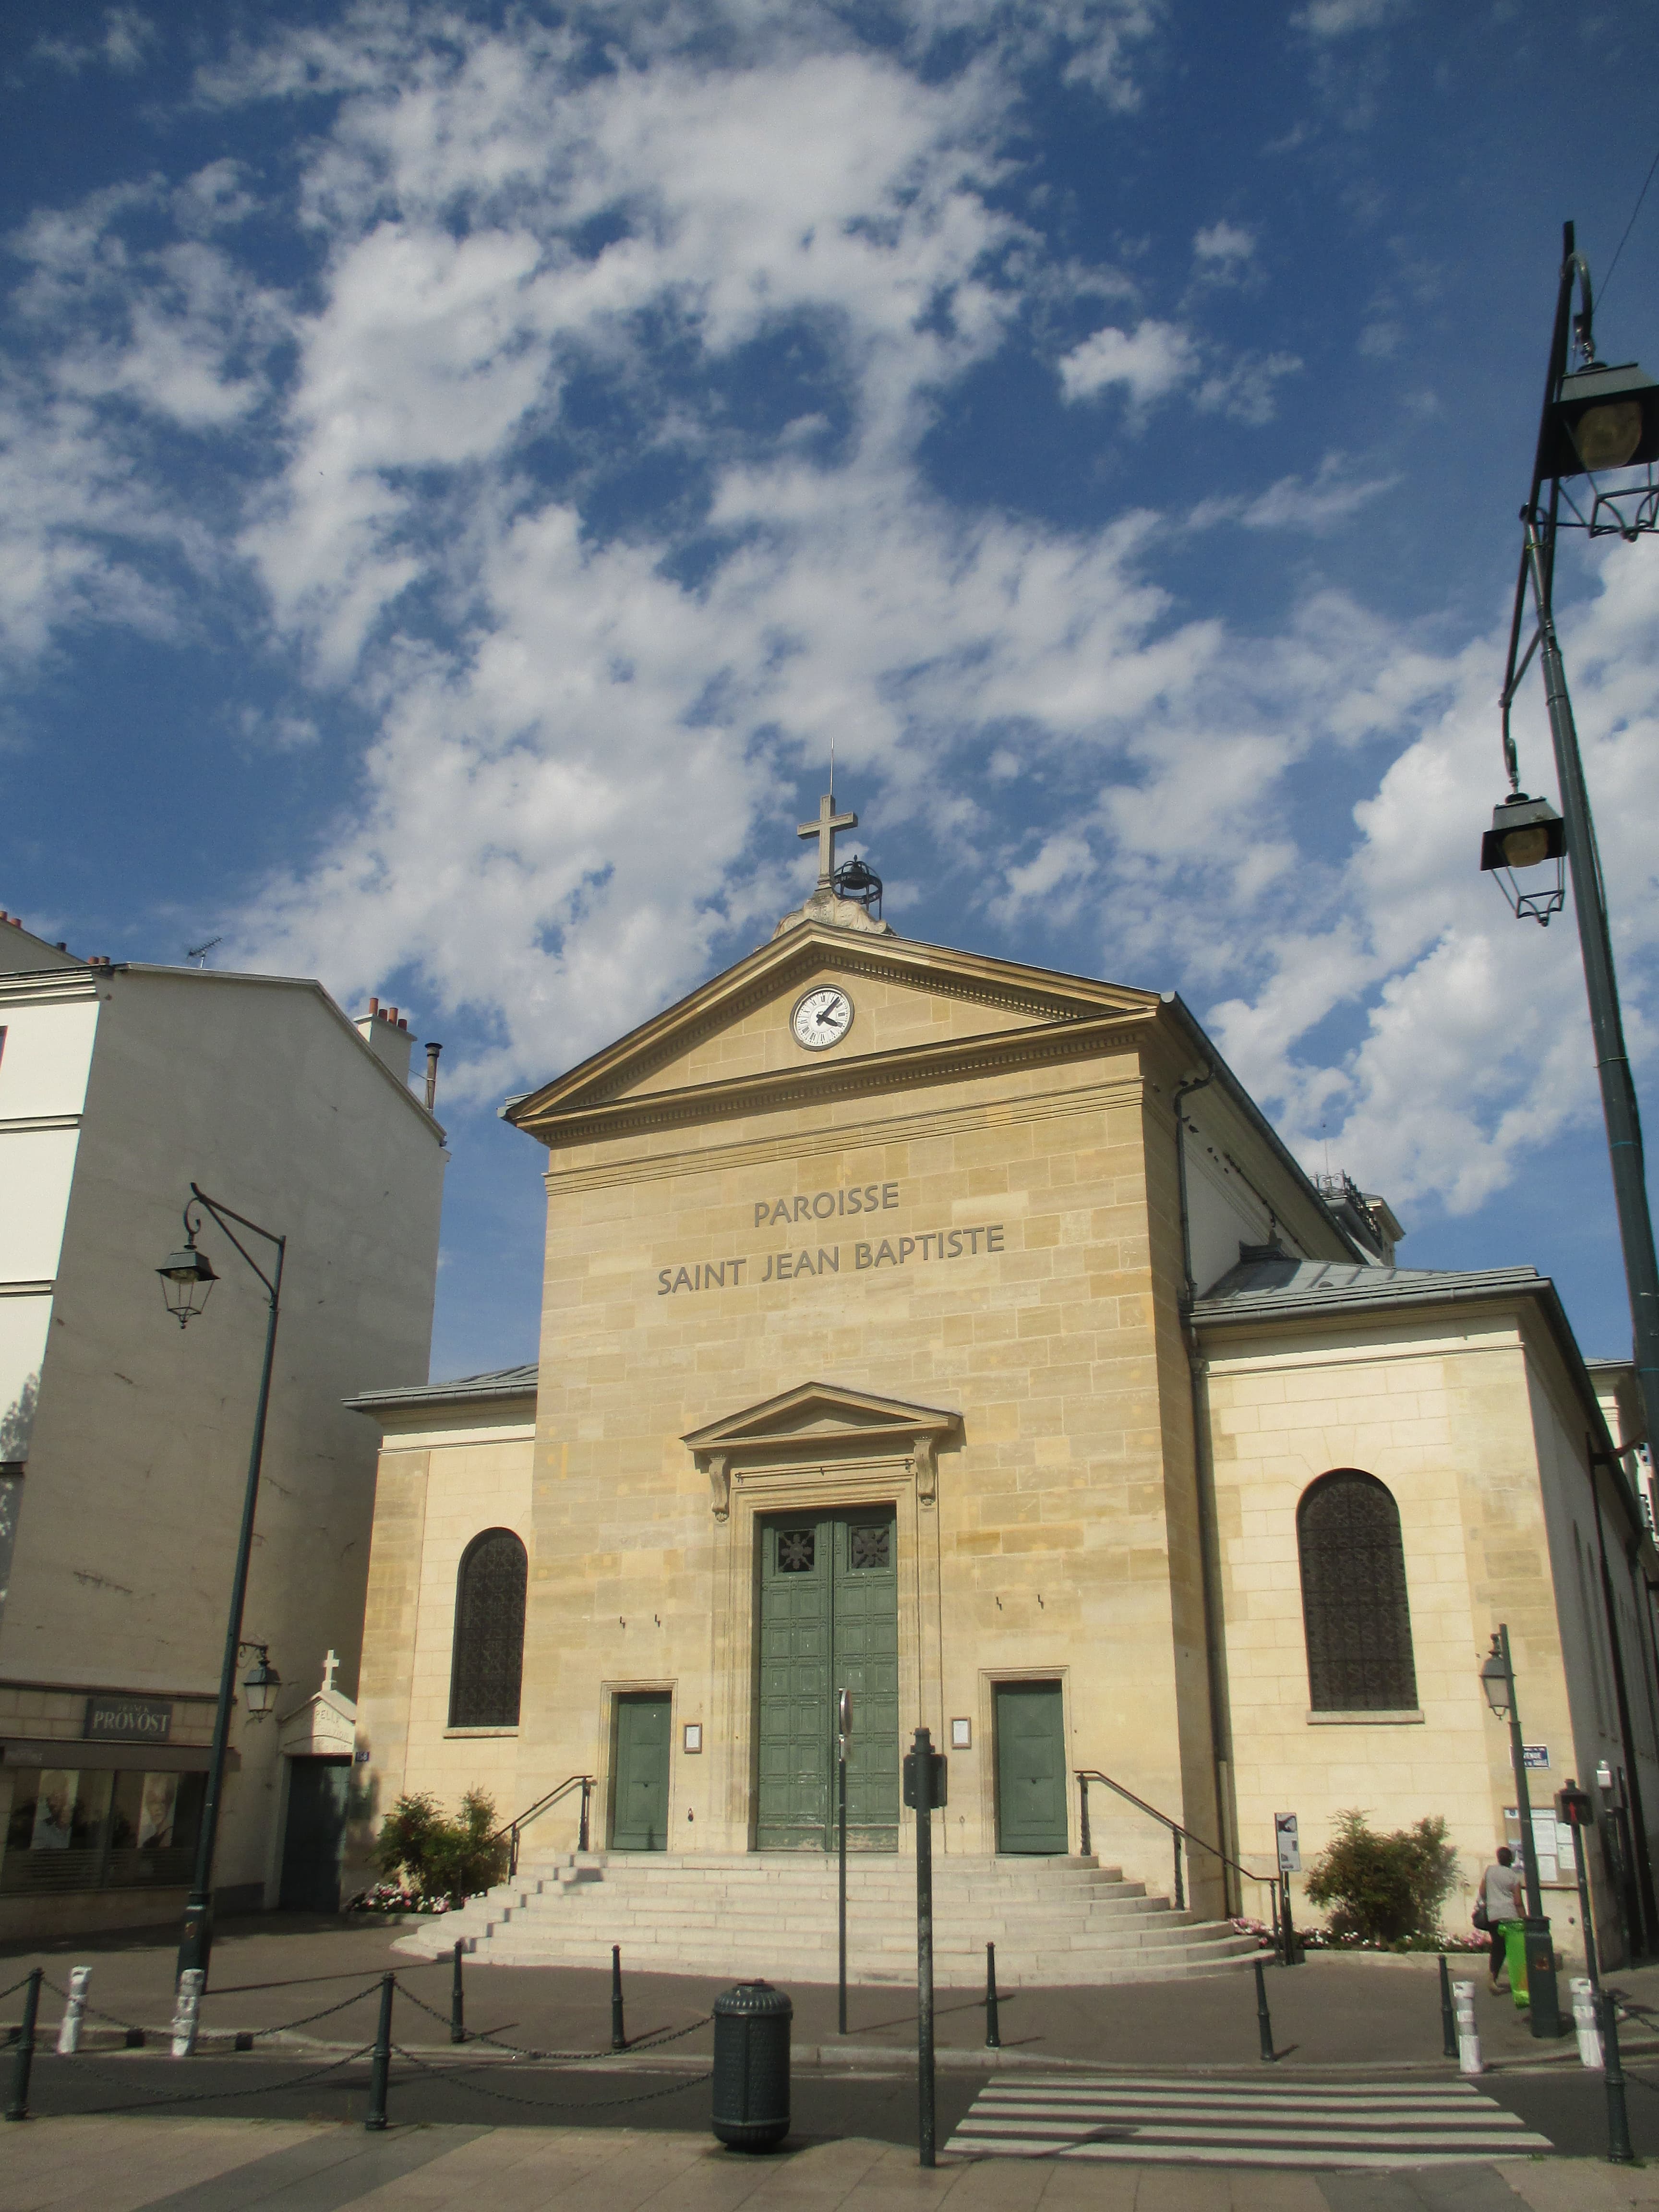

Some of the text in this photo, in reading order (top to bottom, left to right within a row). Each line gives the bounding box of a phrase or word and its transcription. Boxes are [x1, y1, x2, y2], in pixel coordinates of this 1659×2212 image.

[754, 1182, 899, 1227] PAROISSE
[658, 1225, 1005, 1296] SAINT JEAN BAPTISTE
[93, 1710, 170, 1732] PROVOST
